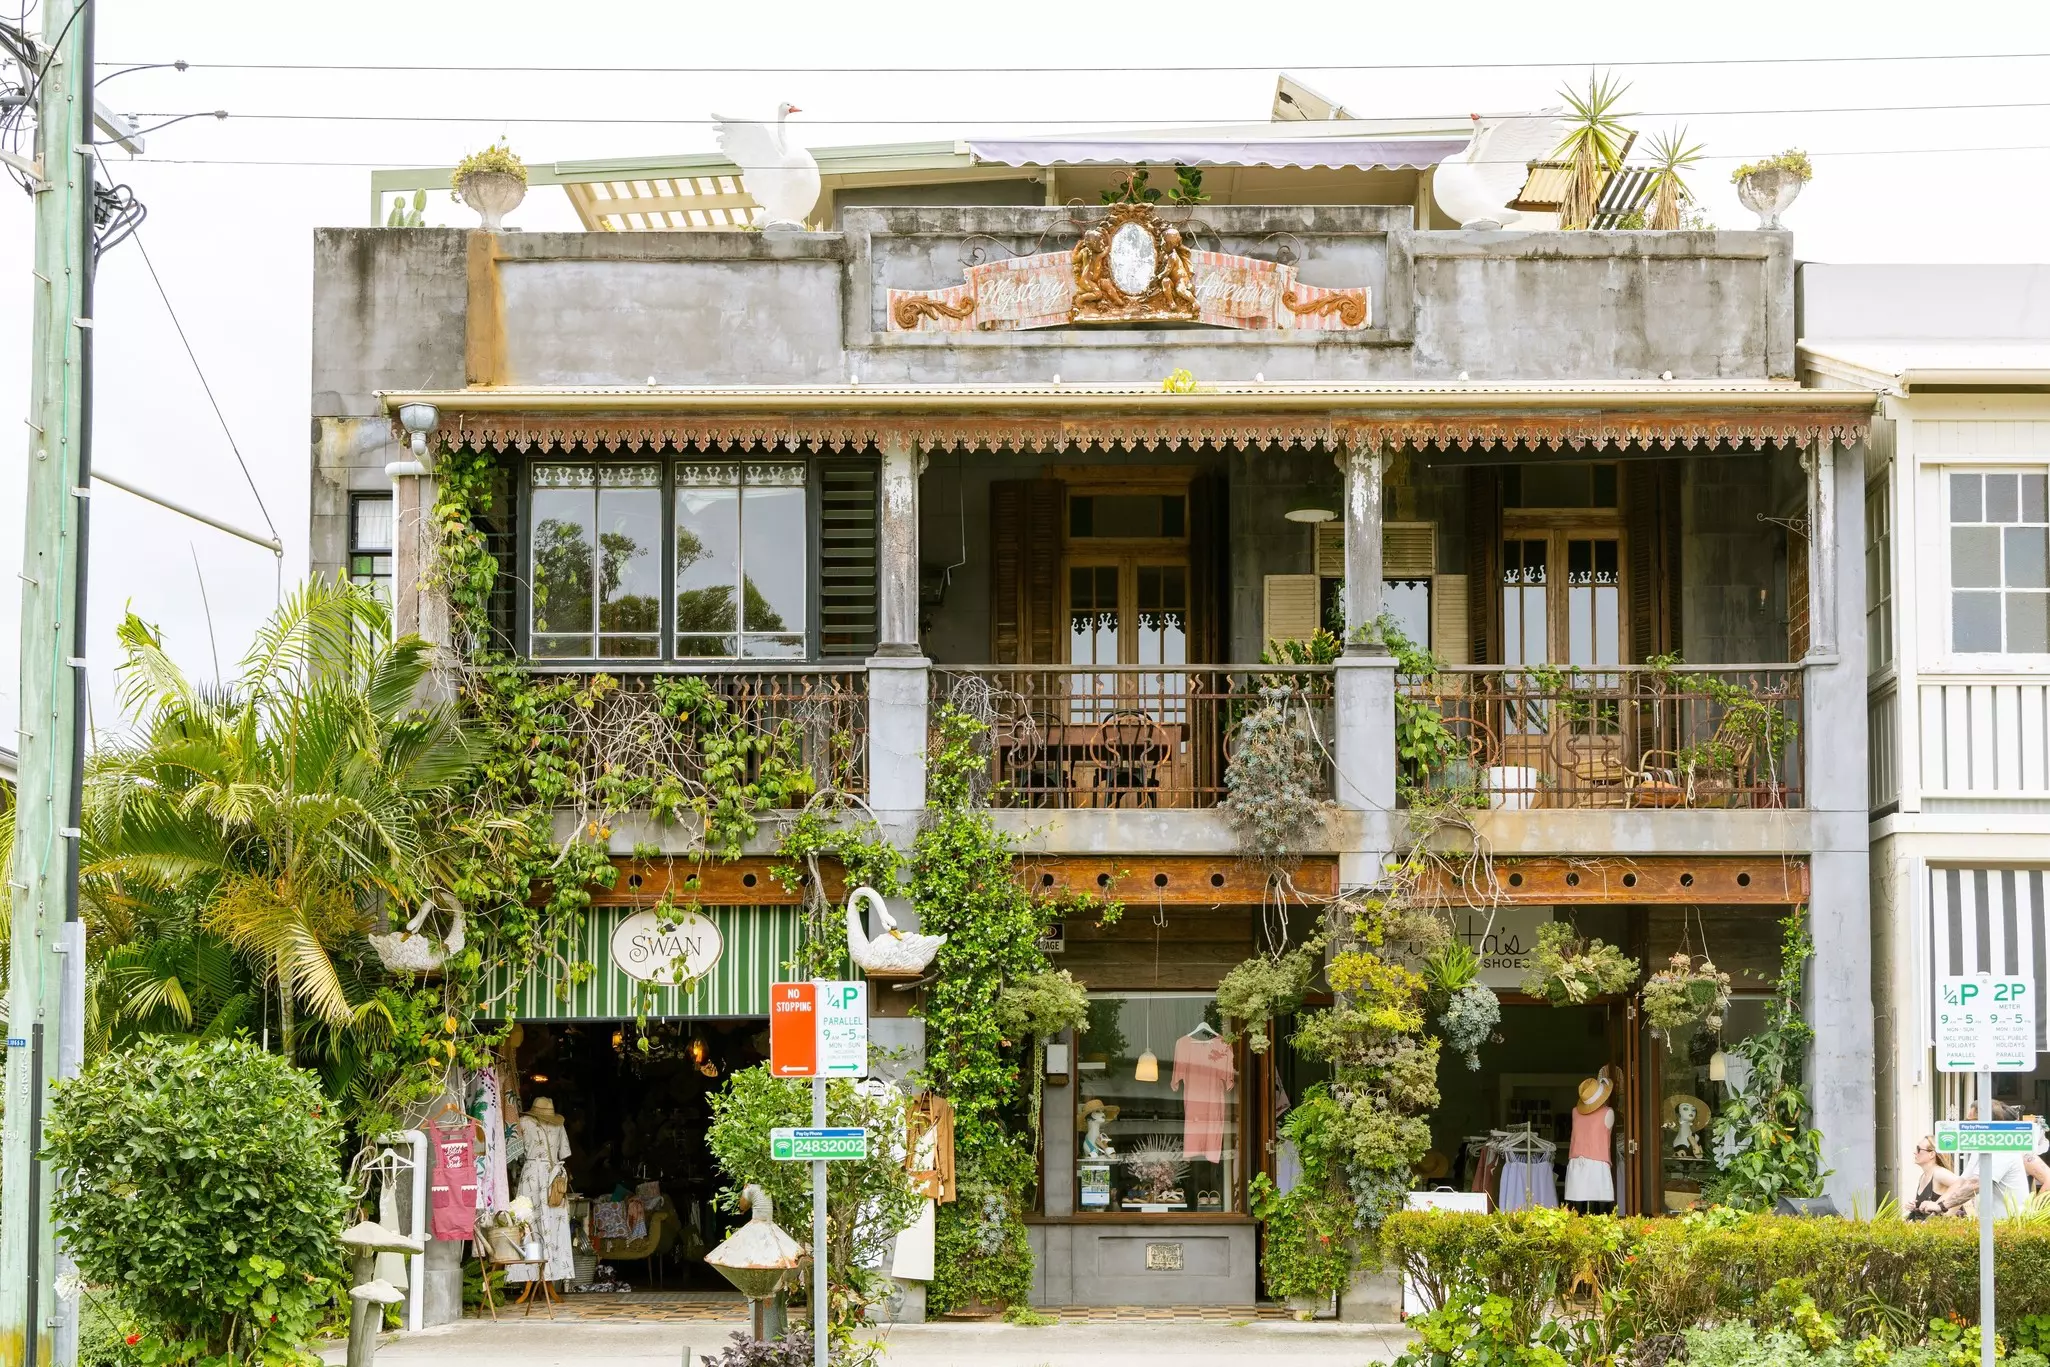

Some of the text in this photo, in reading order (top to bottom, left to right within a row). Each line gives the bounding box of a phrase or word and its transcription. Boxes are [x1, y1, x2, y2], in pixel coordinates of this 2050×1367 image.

[981, 271, 1276, 313] Mystery Adventure
[629, 934, 702, 962] SWAN
[788, 988, 800, 999] NO
[1994, 983, 2026, 1001] 2P
[776, 1001, 812, 1012] STOPPING
[823, 1016, 864, 1026] PARALLEL
[1960, 1133, 2032, 1146] 24832002
[795, 1140, 864, 1152] 24832002
